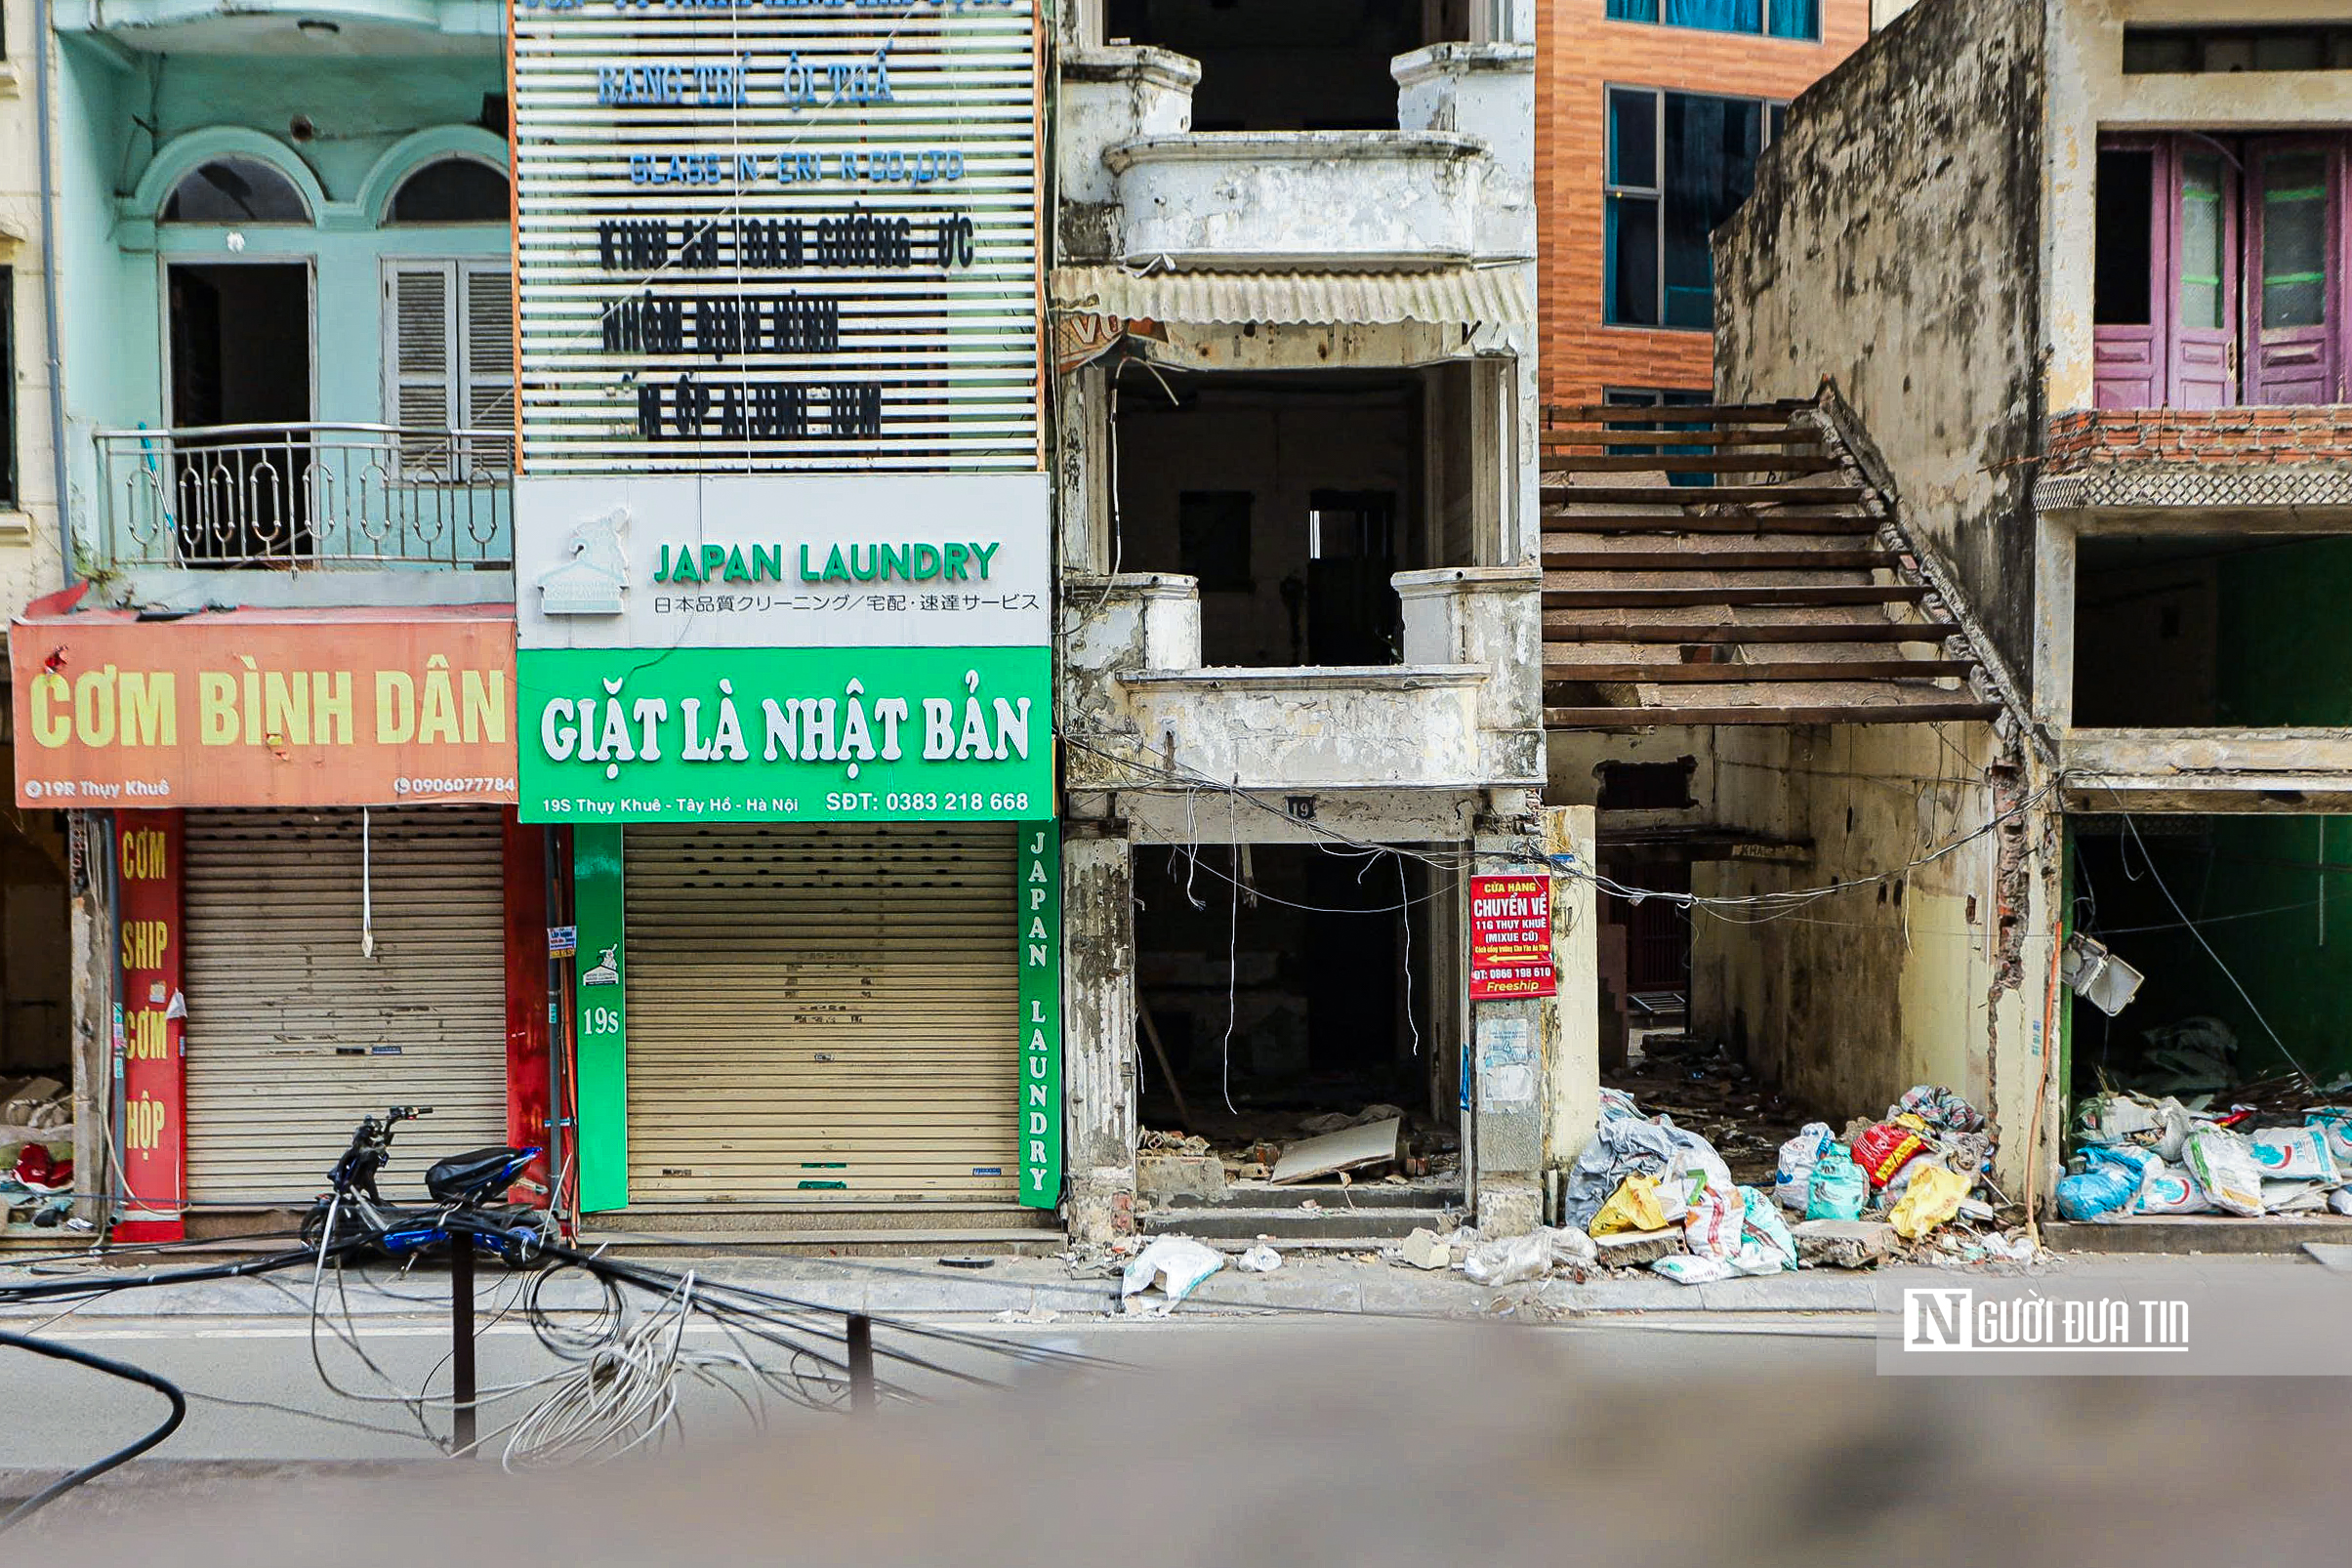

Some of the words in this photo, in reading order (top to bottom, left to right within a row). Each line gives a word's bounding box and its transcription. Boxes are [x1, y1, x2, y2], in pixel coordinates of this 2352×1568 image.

[630, 153, 722, 185] GLASS
[653, 542, 782, 583] JAPAN
[801, 542, 1000, 583] LAUNDRY
[30, 664, 178, 748] CƠM
[199, 654, 354, 746] BÌNH
[375, 654, 507, 744] DÂN
[541, 676, 668, 780] GIẶT
[681, 678, 749, 762] LÀ
[762, 676, 909, 780] NHẬT
[921, 668, 1032, 762] BẢN
[543, 799, 572, 812] 19S
[576, 799, 615, 815] Thụy
[621, 799, 661, 812] Khuê
[677, 798, 705, 815] Tây
[710, 797, 732, 812] Hồ
[746, 798, 767, 812] Hà
[772, 798, 799, 814] Nội
[826, 792, 879, 811] SĐT:
[887, 792, 937, 811] 0383
[944, 792, 983, 811] 218
[990, 792, 1029, 811] 668
[122, 826, 166, 880] CƠM
[1028, 831, 1049, 968] JAPAN
[1531, 891, 1547, 916] VỀ
[122, 920, 168, 970] SHIP
[1485, 932, 1519, 943] (MIXUE
[1487, 980, 1540, 992] Freeship
[125, 1005, 168, 1060] CƠM
[1028, 1000, 1049, 1192] LAUNDRY
[126, 1090, 165, 1162] HỘP
